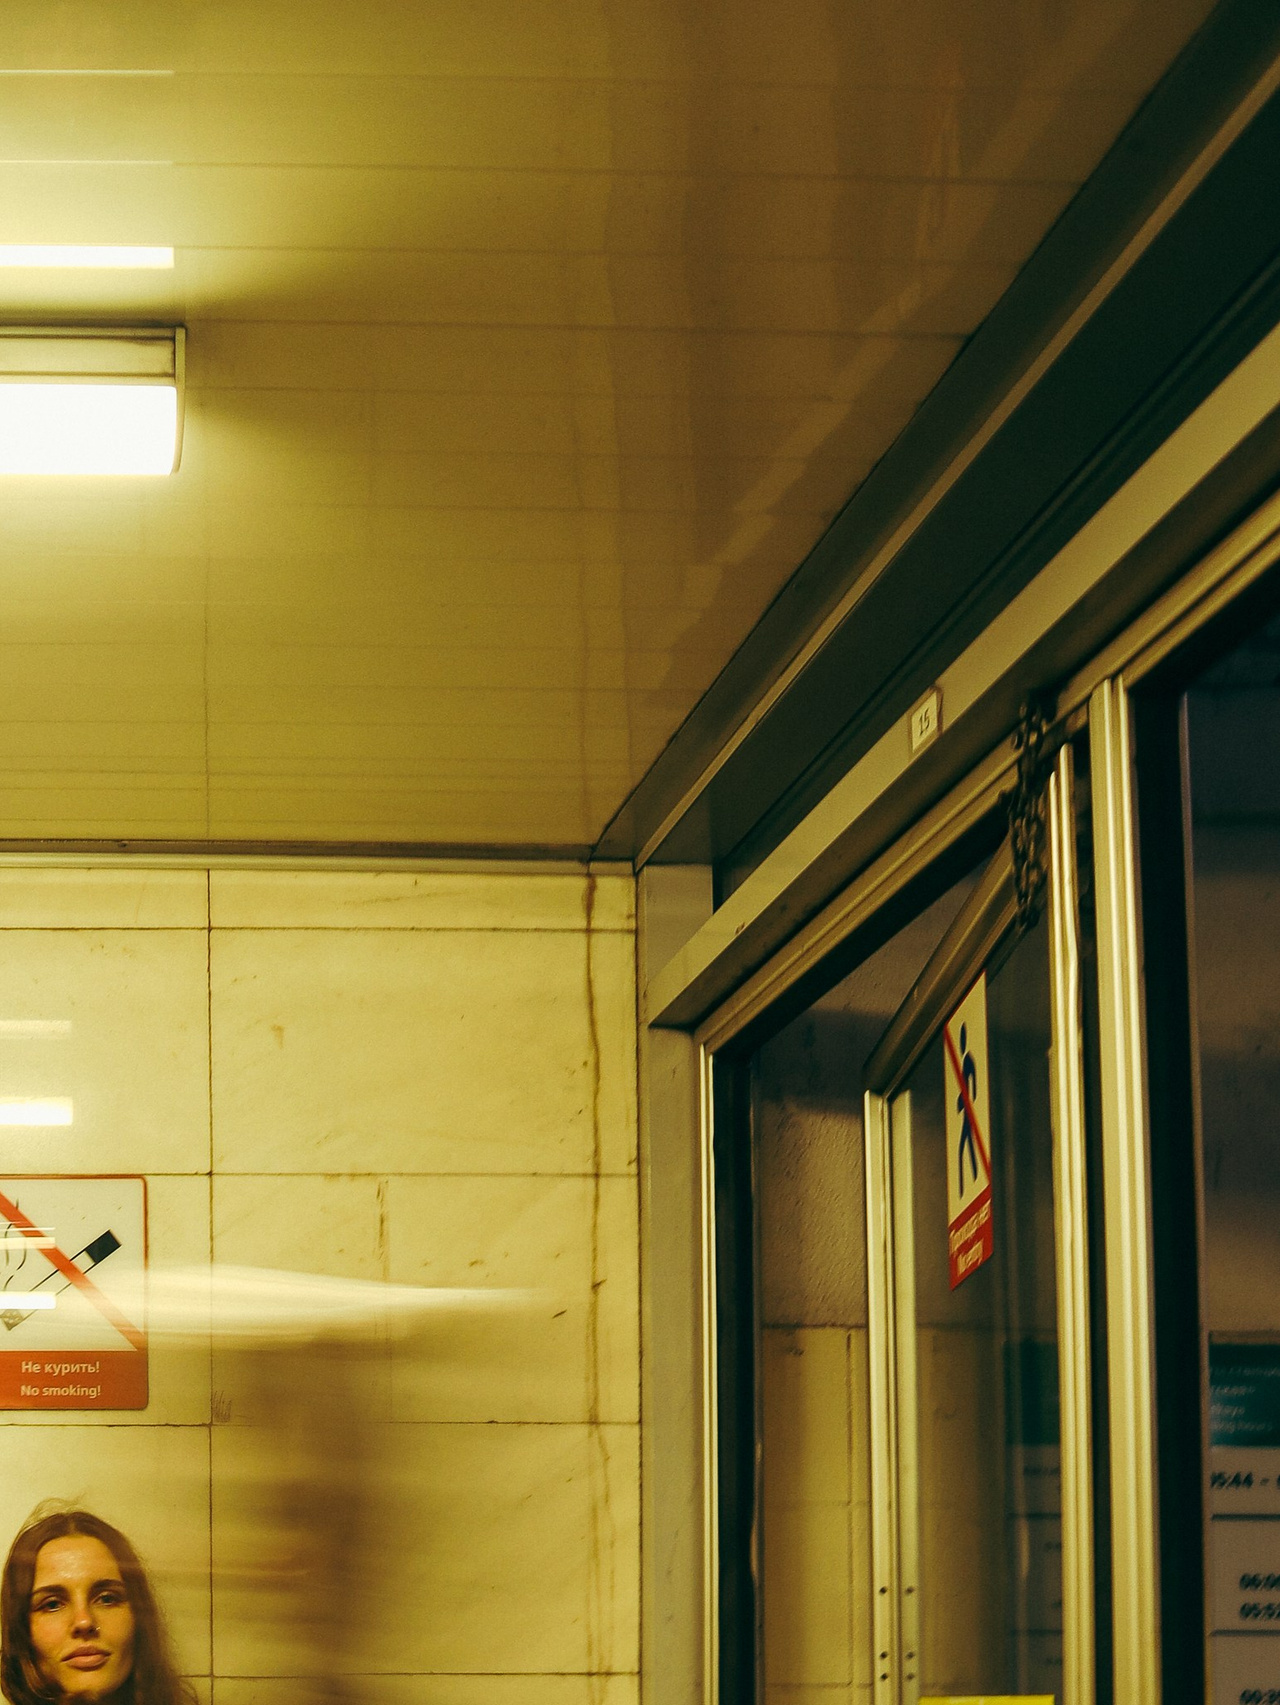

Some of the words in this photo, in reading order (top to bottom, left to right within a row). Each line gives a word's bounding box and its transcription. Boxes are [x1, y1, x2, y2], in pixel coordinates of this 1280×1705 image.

[919, 707, 930, 736] 15
[21, 1361, 41, 1373] Не
[44, 1361, 100, 1376] курить!
[20, 1385, 40, 1396] No
[42, 1384, 101, 1399] smoking!
